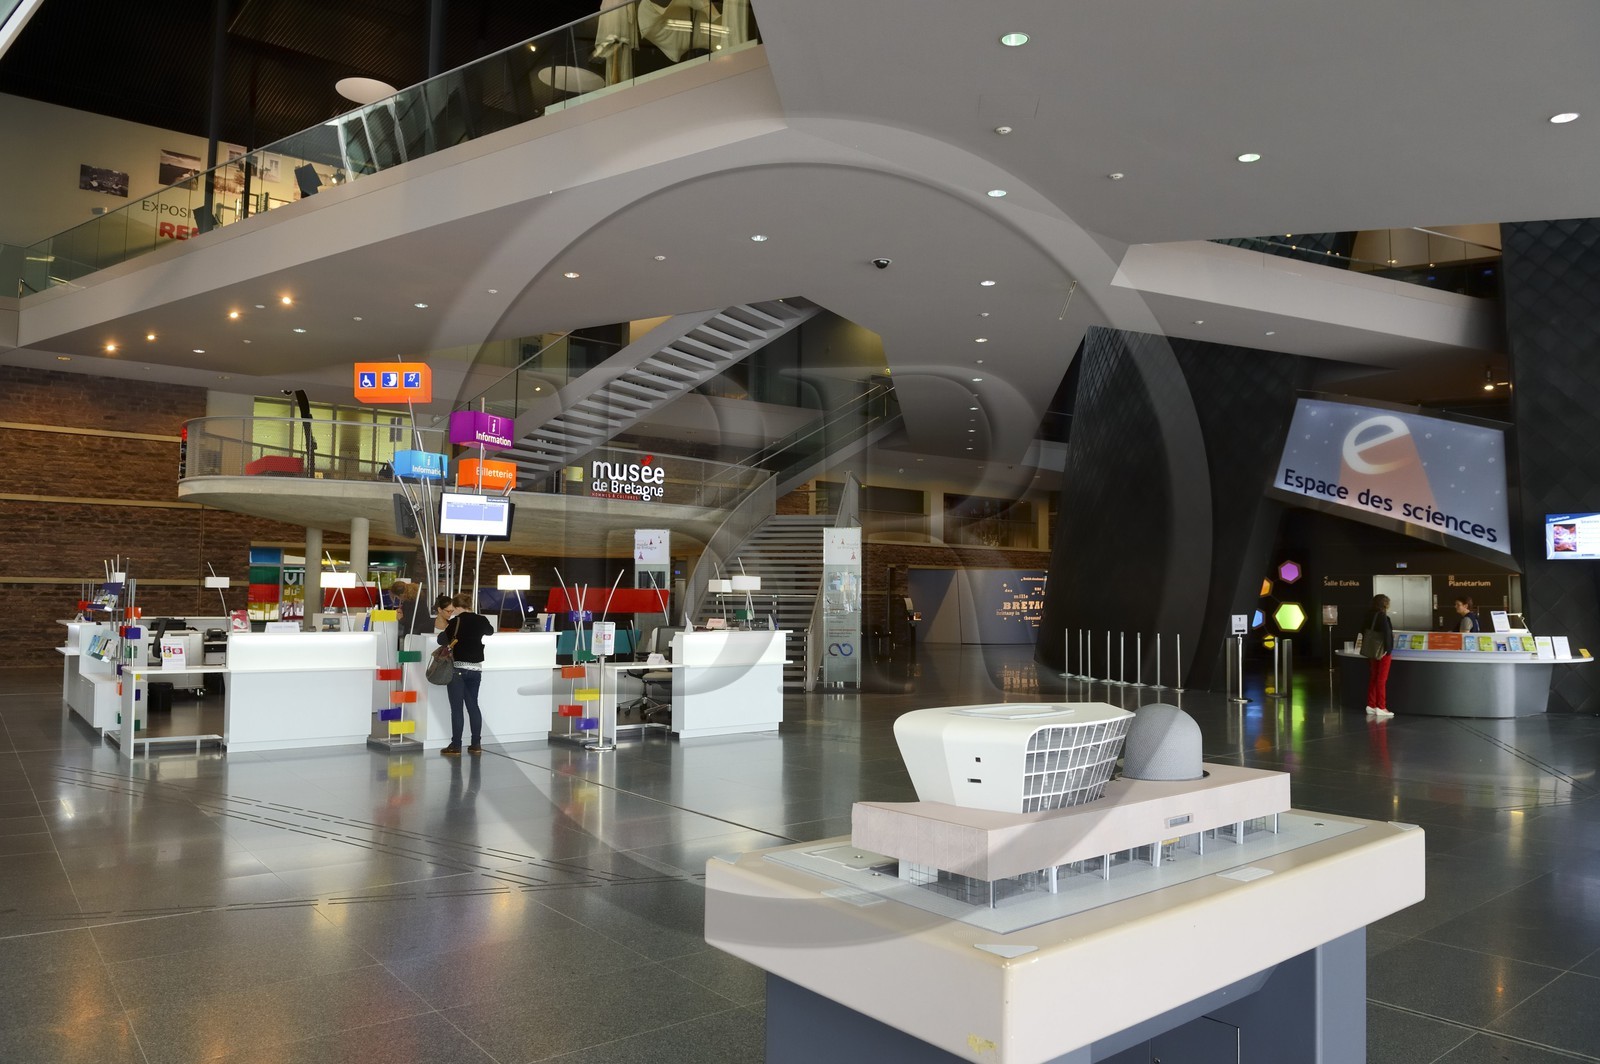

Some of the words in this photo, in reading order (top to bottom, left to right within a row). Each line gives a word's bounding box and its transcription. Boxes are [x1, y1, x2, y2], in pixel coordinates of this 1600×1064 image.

[475, 430, 512, 447] Information
[592, 455, 665, 484] musée
[592, 479, 608, 492] de
[611, 480, 664, 501] Bretagne
[1283, 468, 1349, 500] Espace
[1357, 489, 1393, 512] des
[1402, 503, 1498, 543] sciences
[1449, 578, 1491, 587] Planétarium
